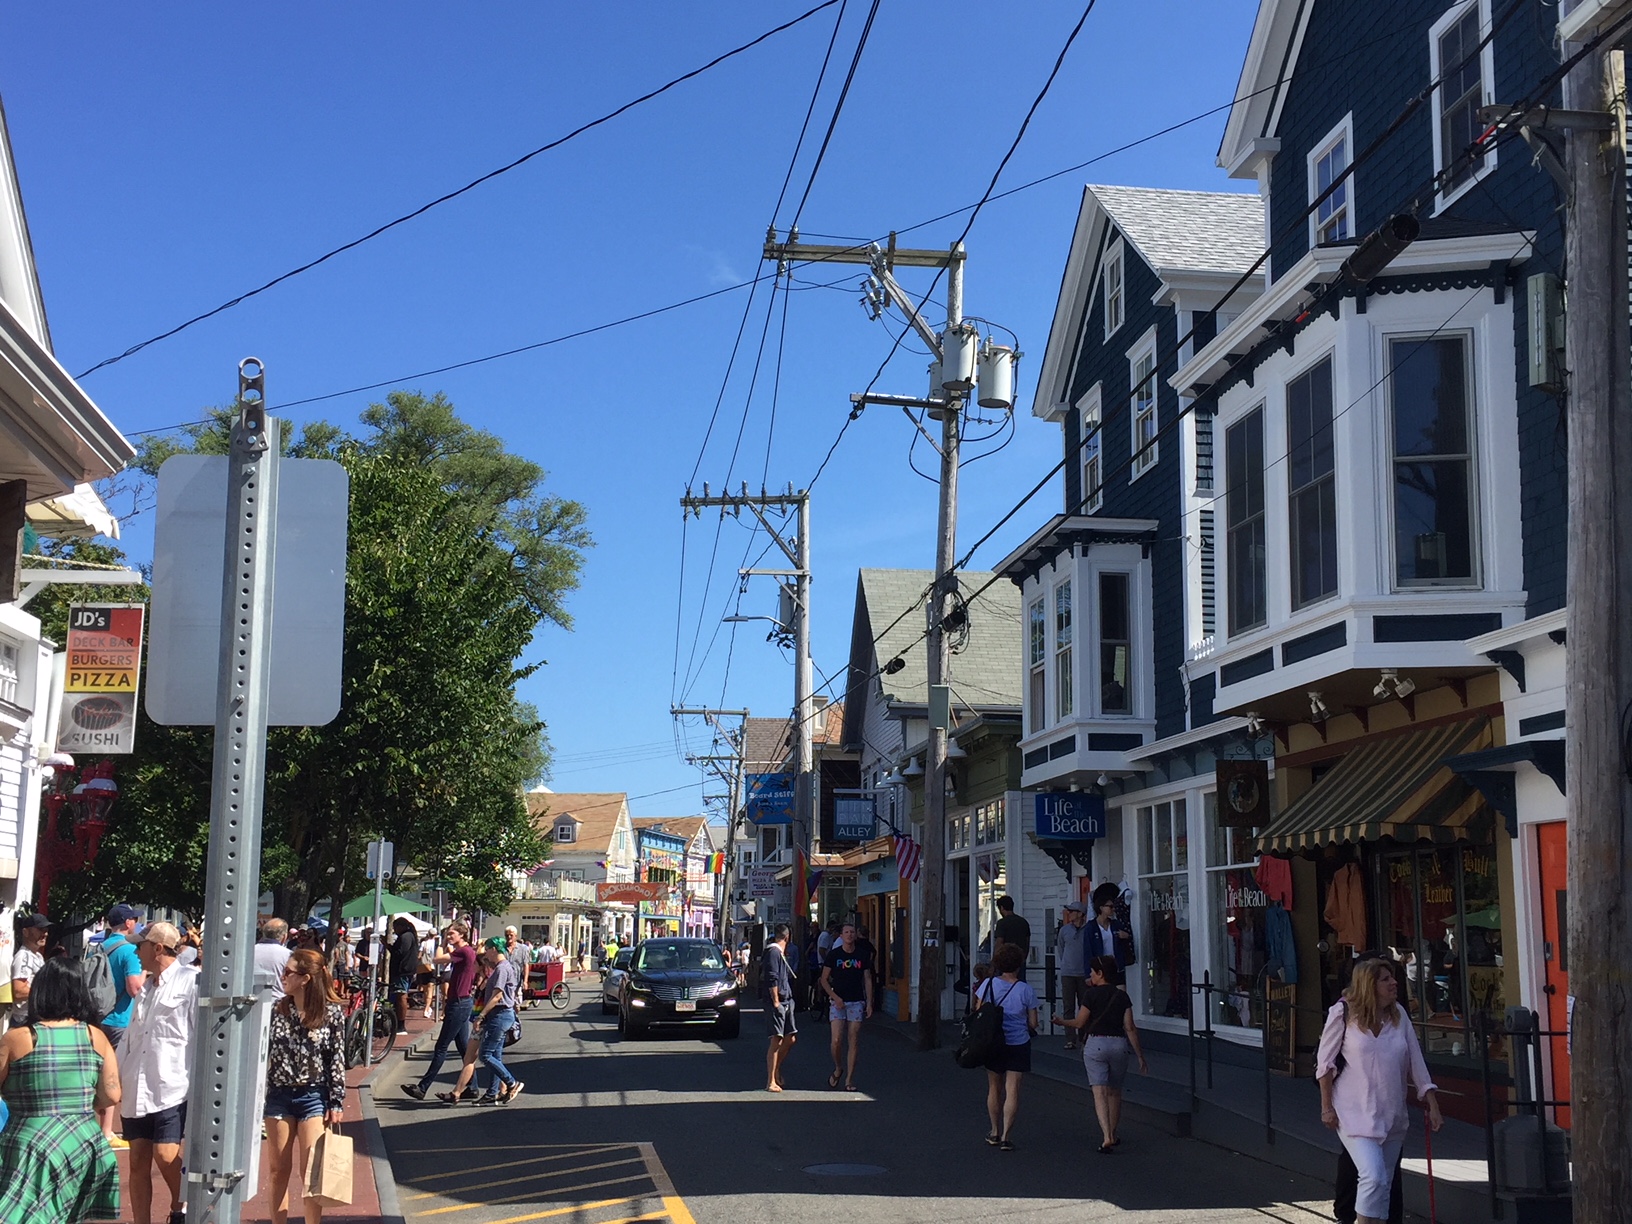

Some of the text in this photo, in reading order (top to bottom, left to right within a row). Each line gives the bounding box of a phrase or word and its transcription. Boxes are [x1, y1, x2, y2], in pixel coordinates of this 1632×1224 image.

[74, 611, 106, 627] JD's
[73, 636, 134, 648] DECK BAR
[71, 654, 133, 666] BURGERS
[69, 672, 131, 687] PIZZA
[71, 732, 119, 746] SUSHI
[838, 801, 872, 812] TIN
[1044, 795, 1074, 816] Life
[839, 813, 872, 824] PAN
[1050, 815, 1099, 834] Beach
[837, 827, 871, 837] ALLEY
[1463, 850, 1489, 877] Bull
[1224, 884, 1238, 908] Life
[1425, 884, 1453, 906] Leather
